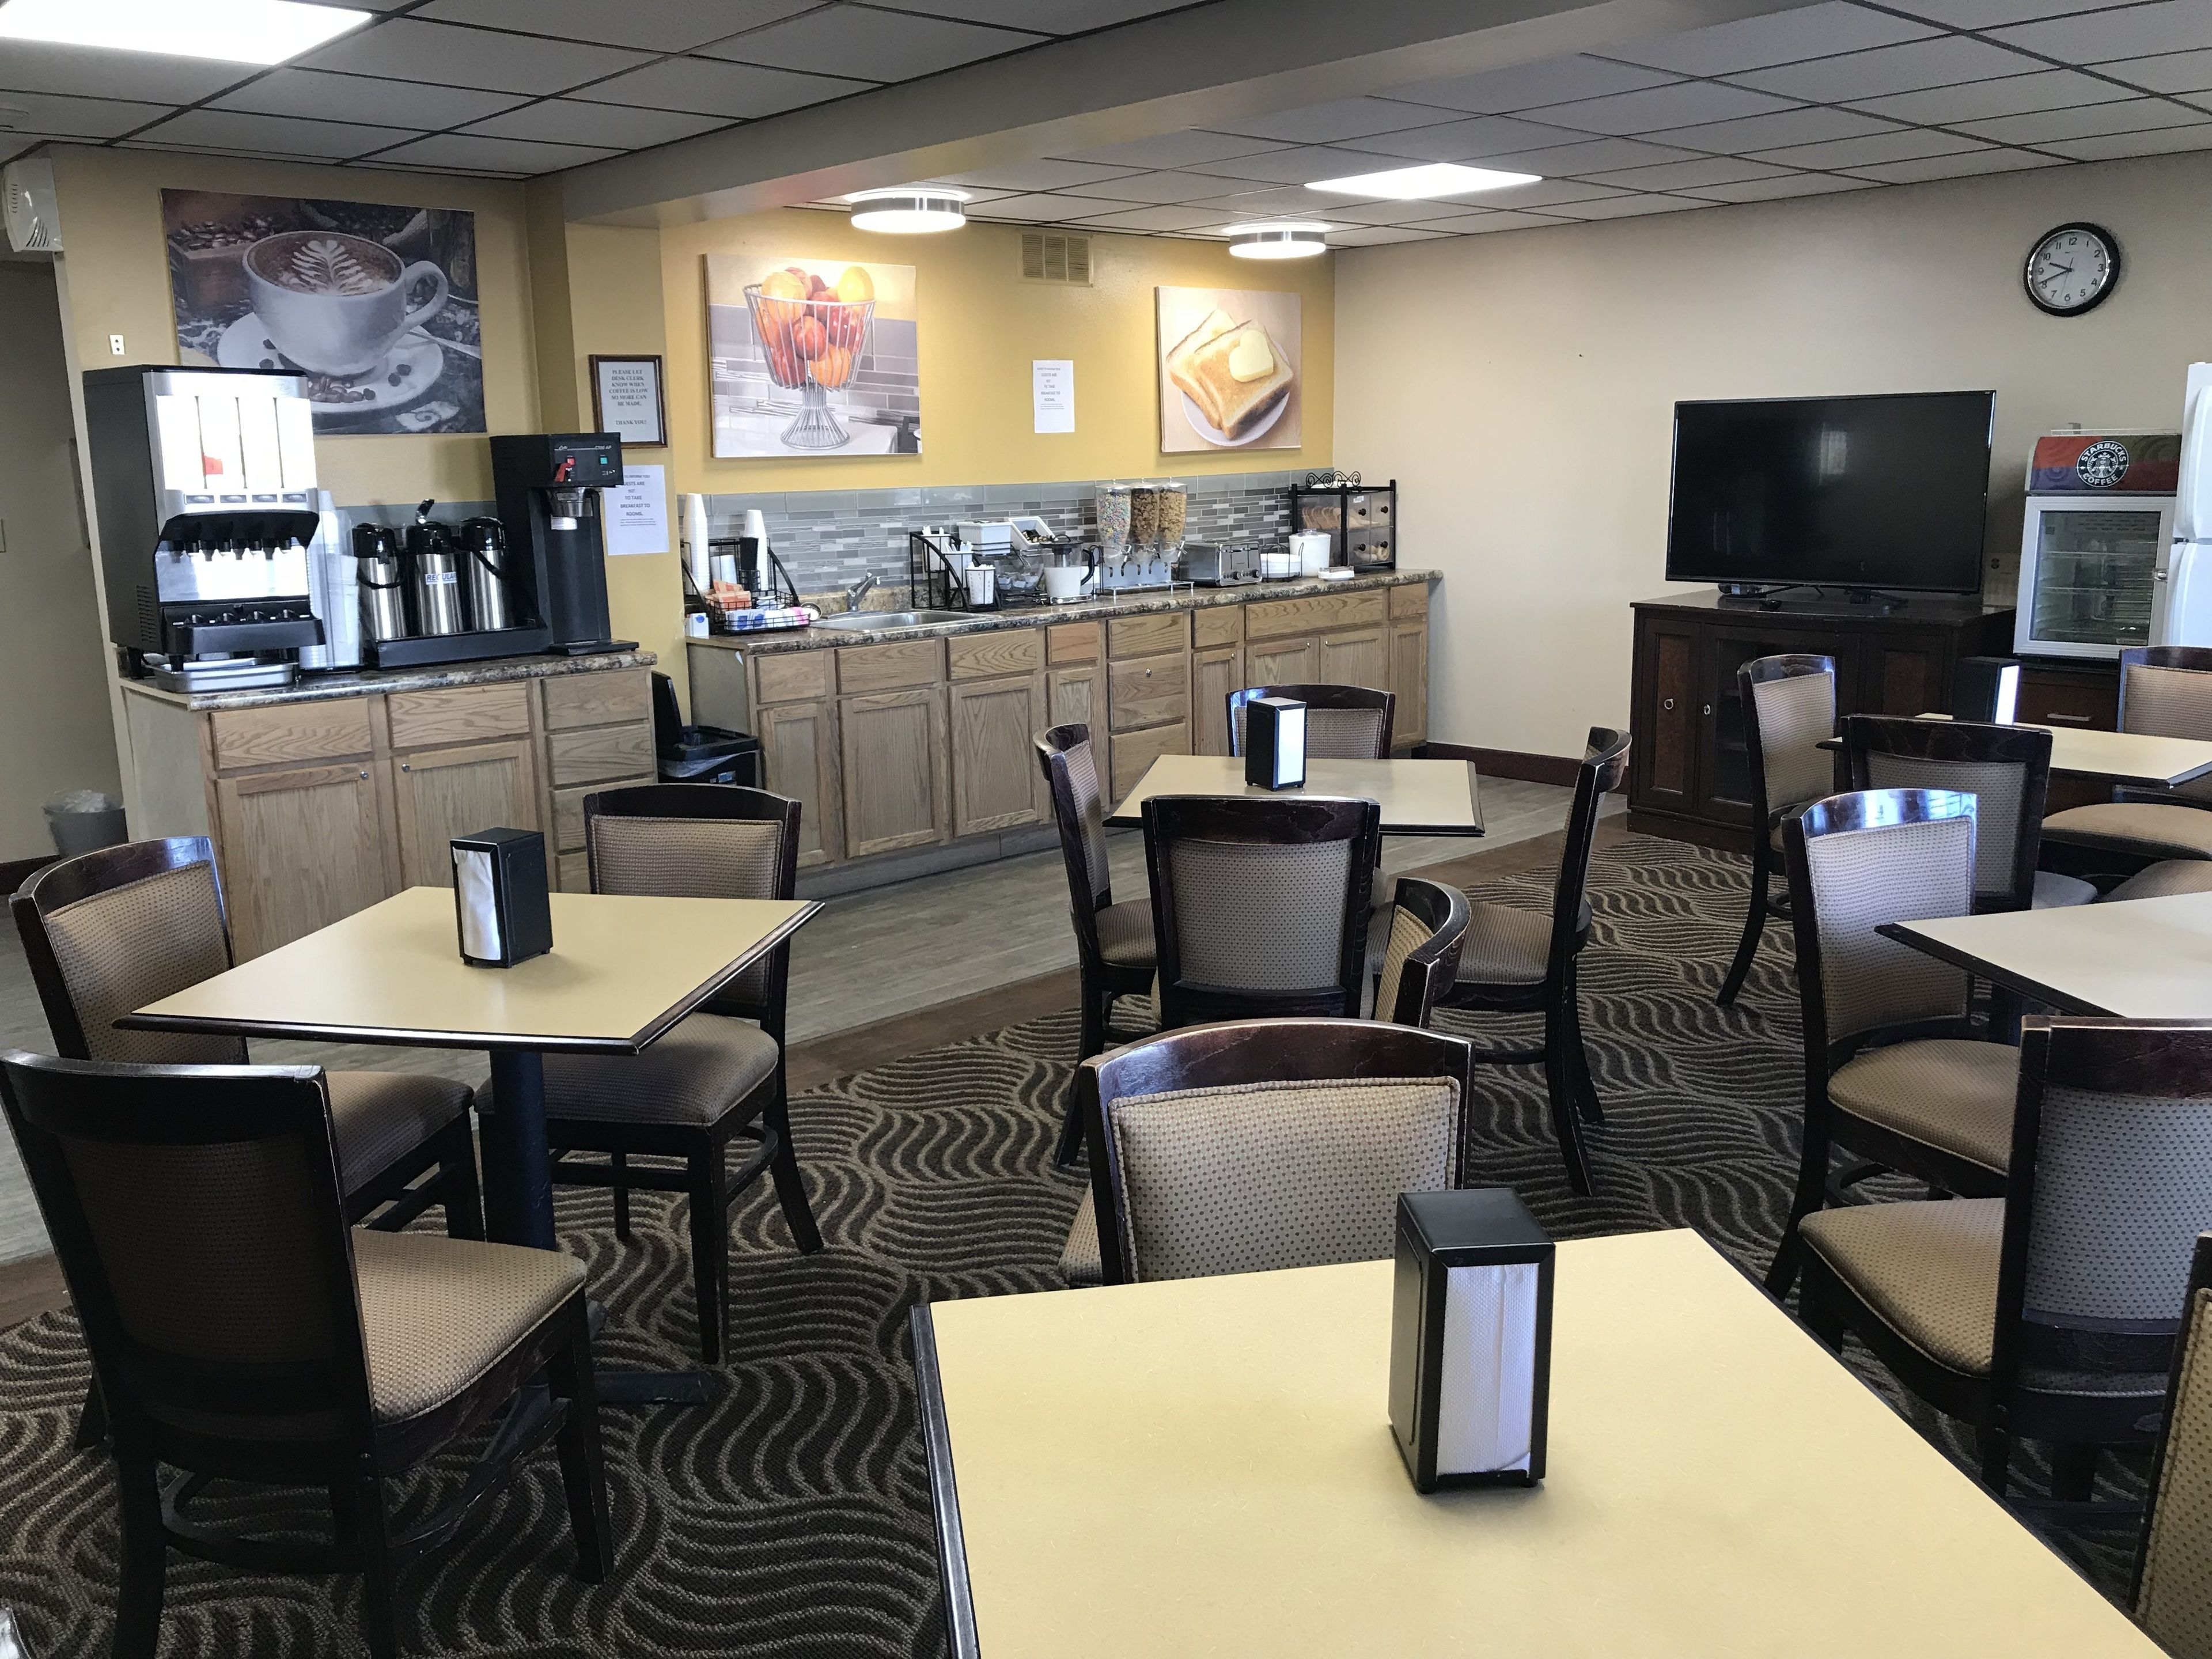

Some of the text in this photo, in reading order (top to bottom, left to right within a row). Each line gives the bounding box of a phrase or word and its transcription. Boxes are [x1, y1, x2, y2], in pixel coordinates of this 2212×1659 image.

[2069, 237, 2077, 245] 12
[2086, 240, 2089, 248] 1
[2043, 253, 2051, 261] 10
[2094, 249, 2101, 258] 2
[2097, 263, 2104, 272] 3
[2041, 280, 2047, 289] 8
[2091, 278, 2097, 286] 4
[2051, 290, 2058, 298] 7
[2080, 289, 2086, 297] 5
[2081, 442, 2127, 462] STARBUCKS
[2082, 472, 2118, 485] COFFEE
